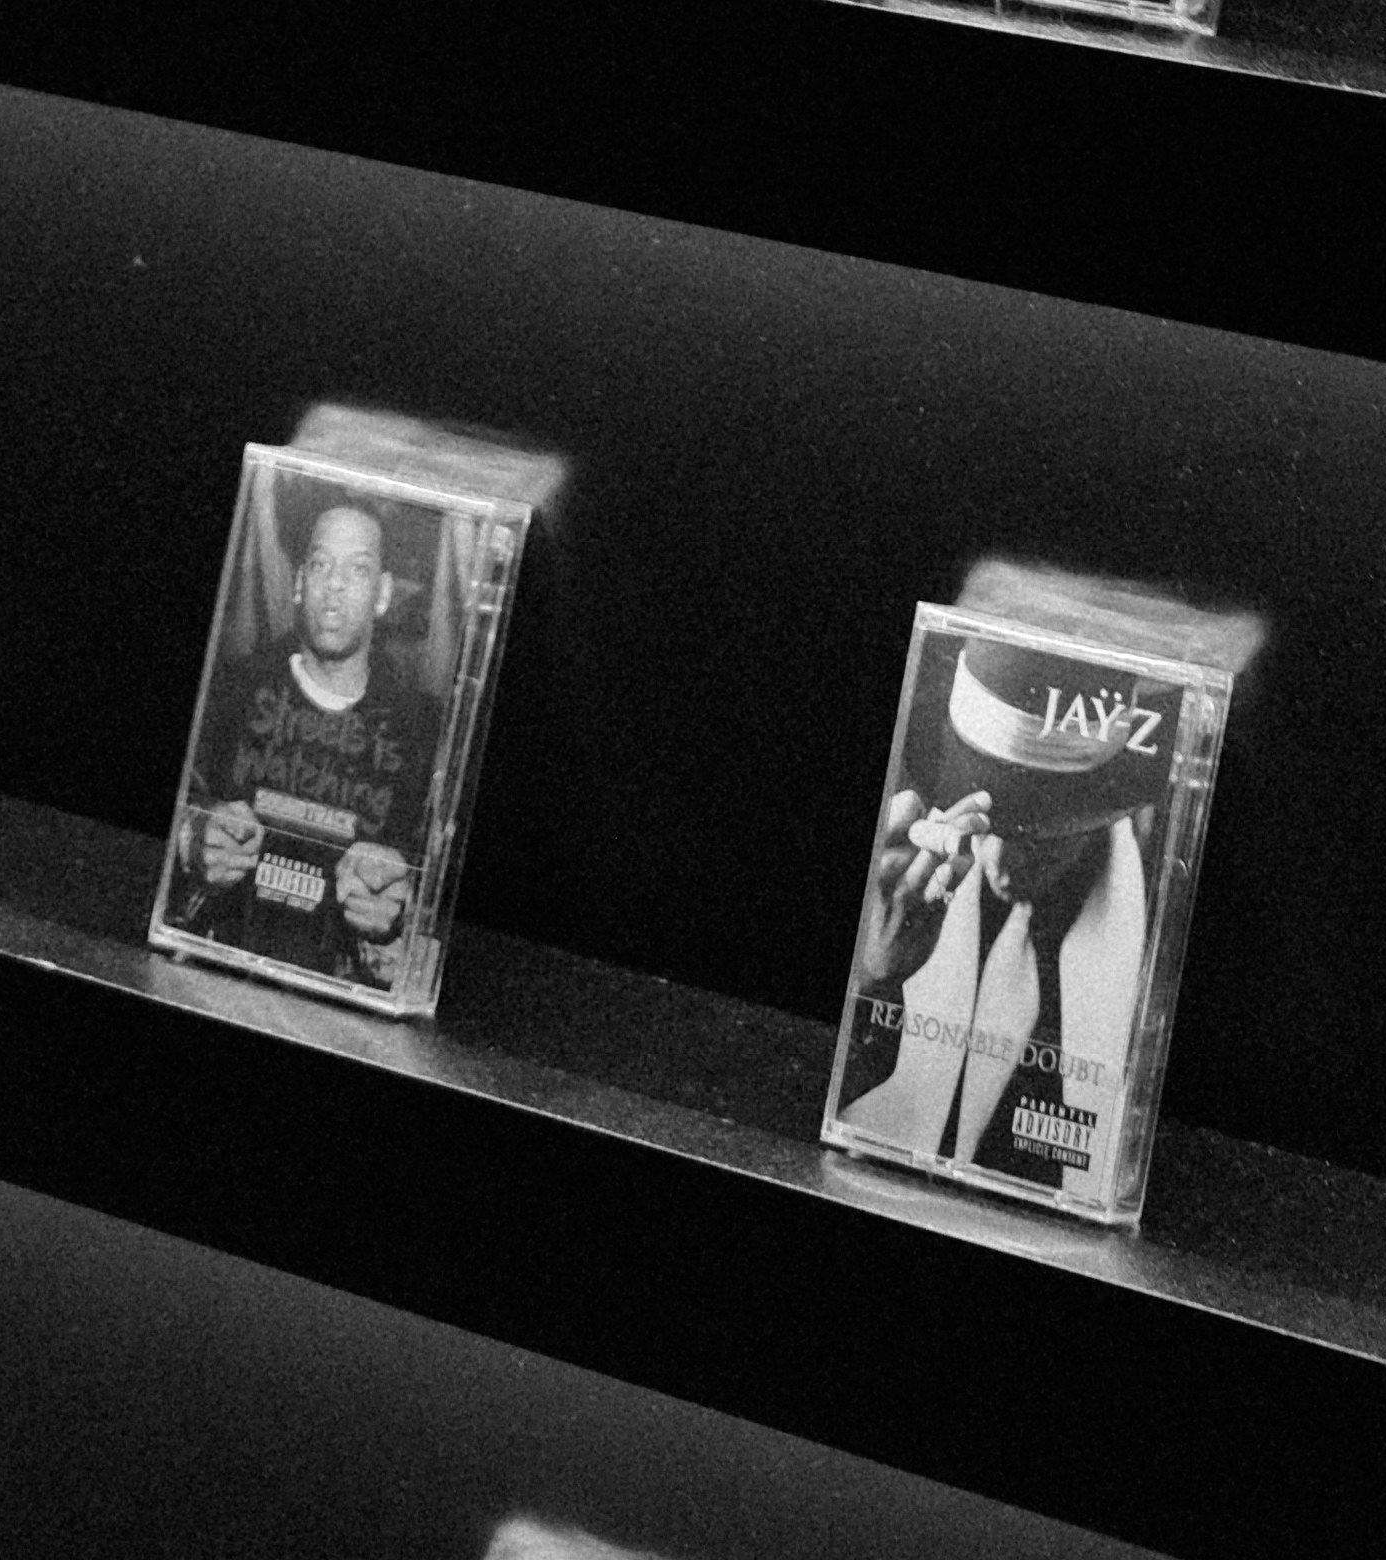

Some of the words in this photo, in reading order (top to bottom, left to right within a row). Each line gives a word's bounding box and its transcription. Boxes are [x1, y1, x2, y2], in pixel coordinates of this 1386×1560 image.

[869, 1000, 1015, 1062] REASONABLE
[1018, 1043, 1106, 1087] DOUBT
[1015, 1110, 1090, 1151] ADVISORY
